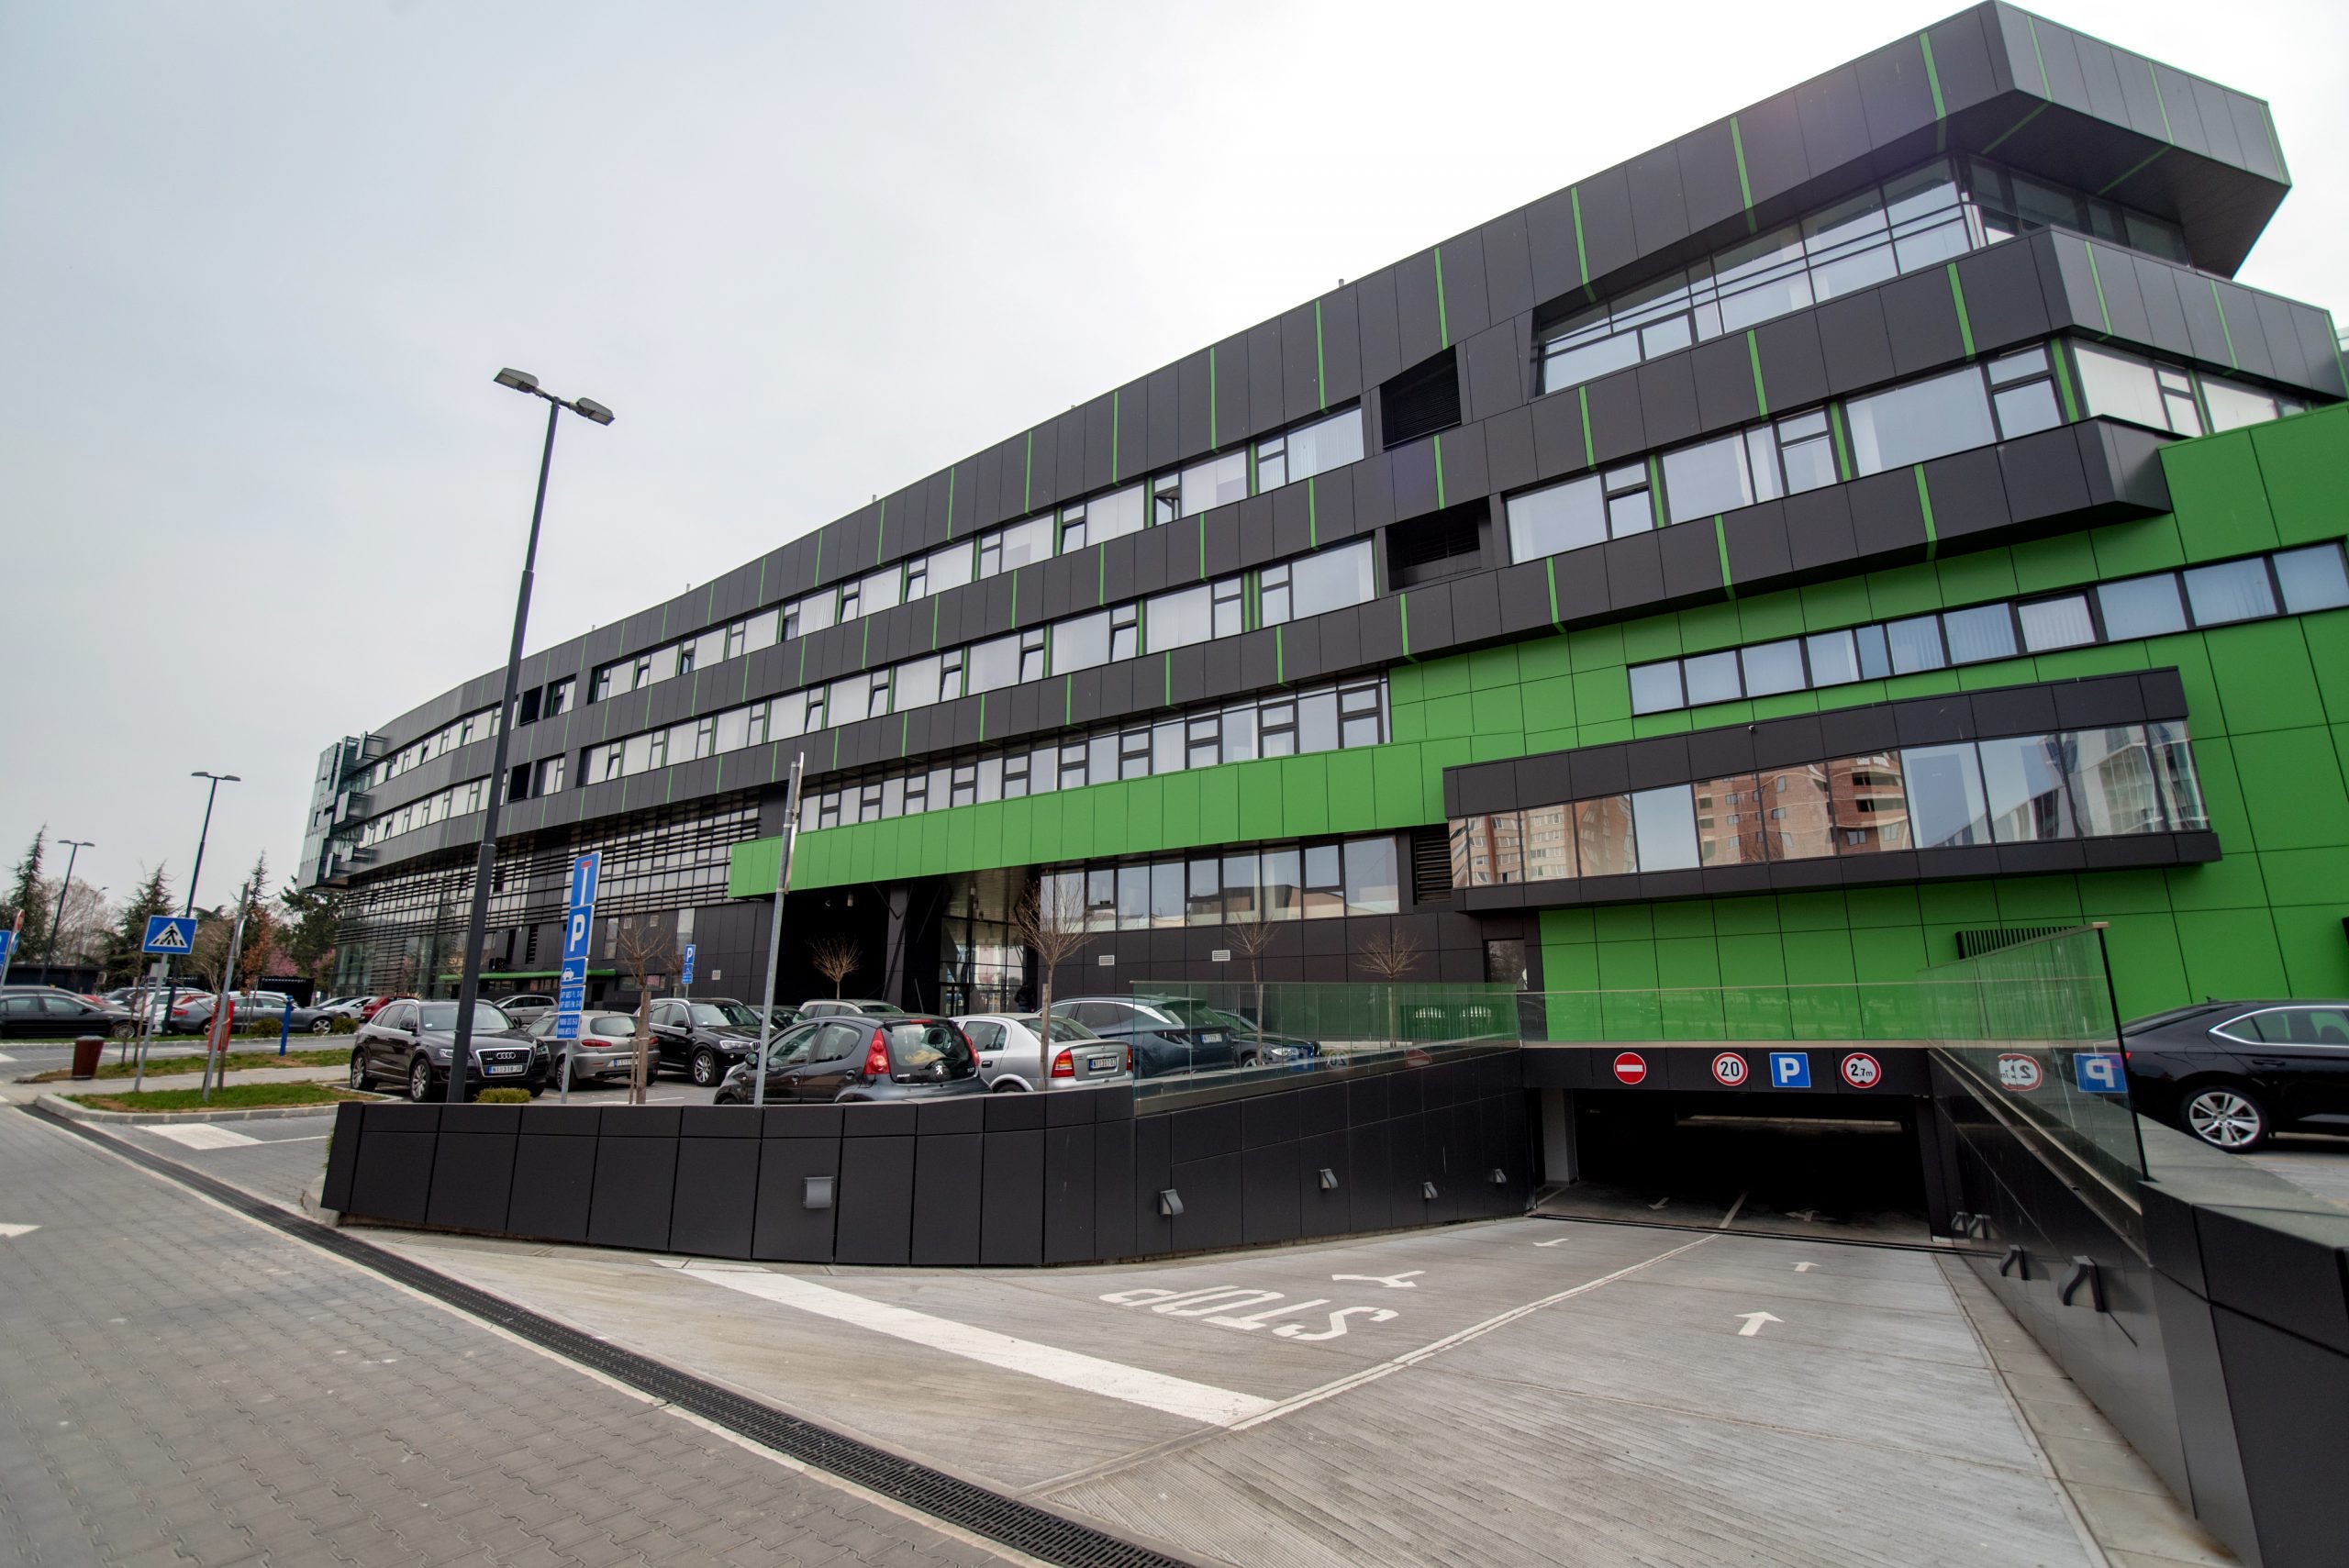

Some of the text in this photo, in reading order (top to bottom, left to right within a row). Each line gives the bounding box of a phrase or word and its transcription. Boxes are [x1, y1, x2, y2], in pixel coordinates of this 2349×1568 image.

[570, 914, 585, 951] P
[686, 947, 694, 962] P
[1720, 1062, 1740, 1077] 20
[1778, 1057, 1801, 1084] P
[1098, 1284, 1400, 1341] STOP
